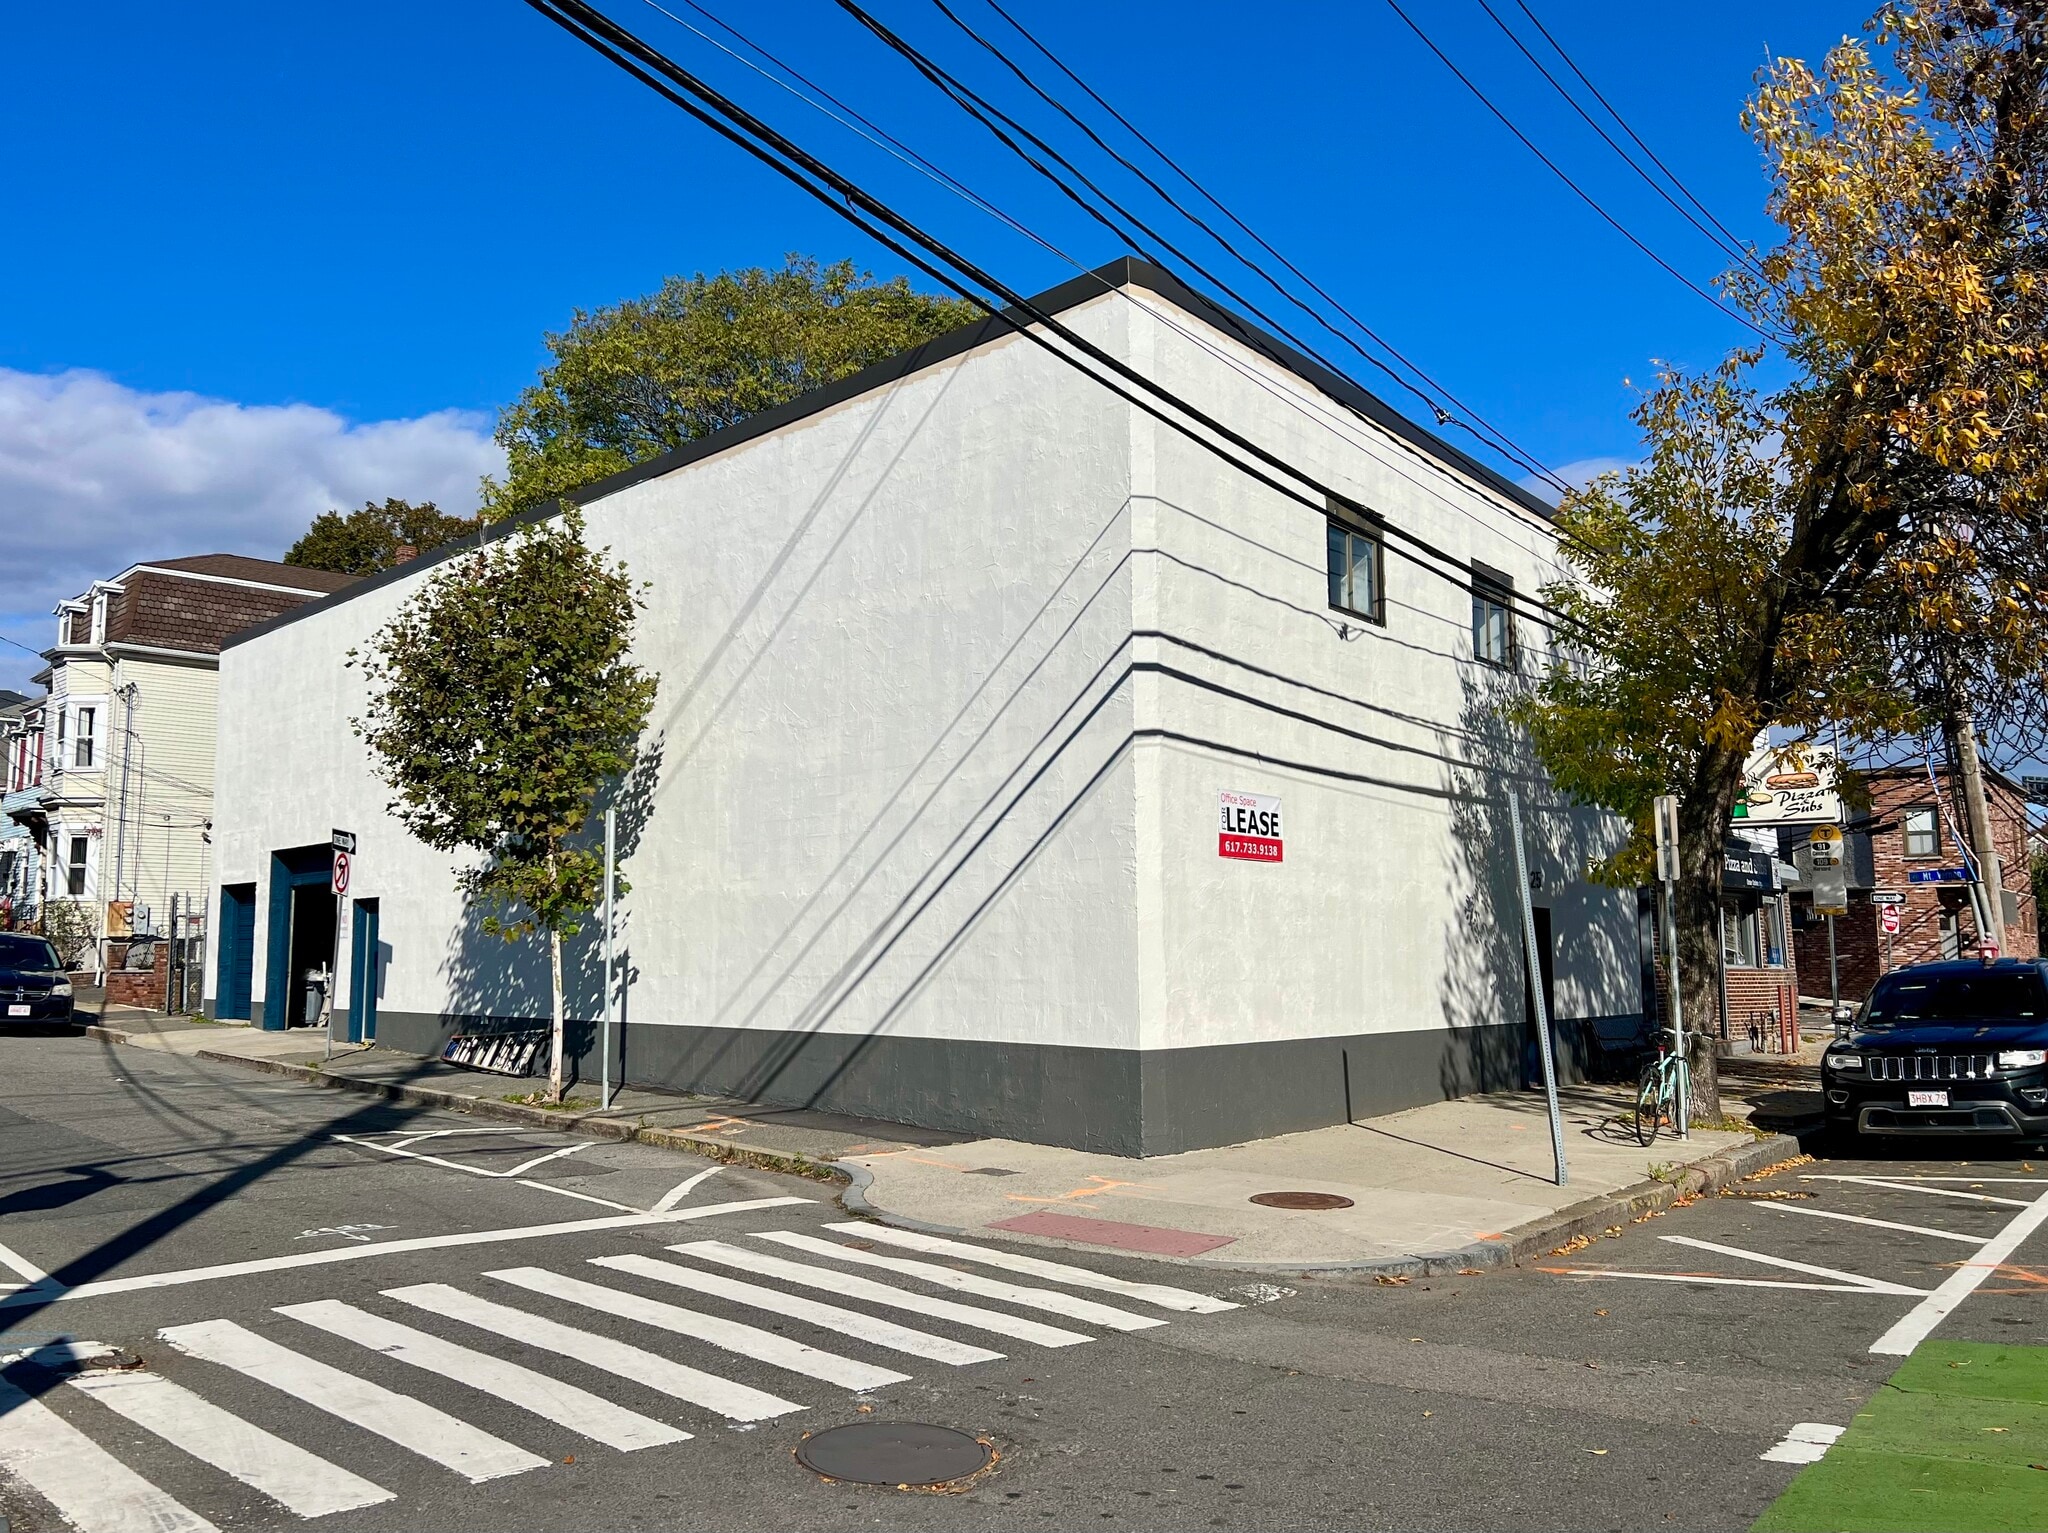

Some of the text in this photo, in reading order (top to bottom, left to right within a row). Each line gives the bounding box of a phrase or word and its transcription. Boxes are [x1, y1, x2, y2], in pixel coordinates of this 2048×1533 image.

[1220, 792, 1257, 807] Office Space
[1773, 789, 1825, 806] Pizza
[1782, 800, 1823, 818] Subs
[1226, 806, 1280, 838] LEASE
[1225, 840, 1278, 857] 617.733.9138
[1724, 853, 1741, 872] Pizza
[1741, 857, 1754, 874] and
[1530, 871, 1541, 889] 25
[1935, 1094, 1947, 1104] 79
